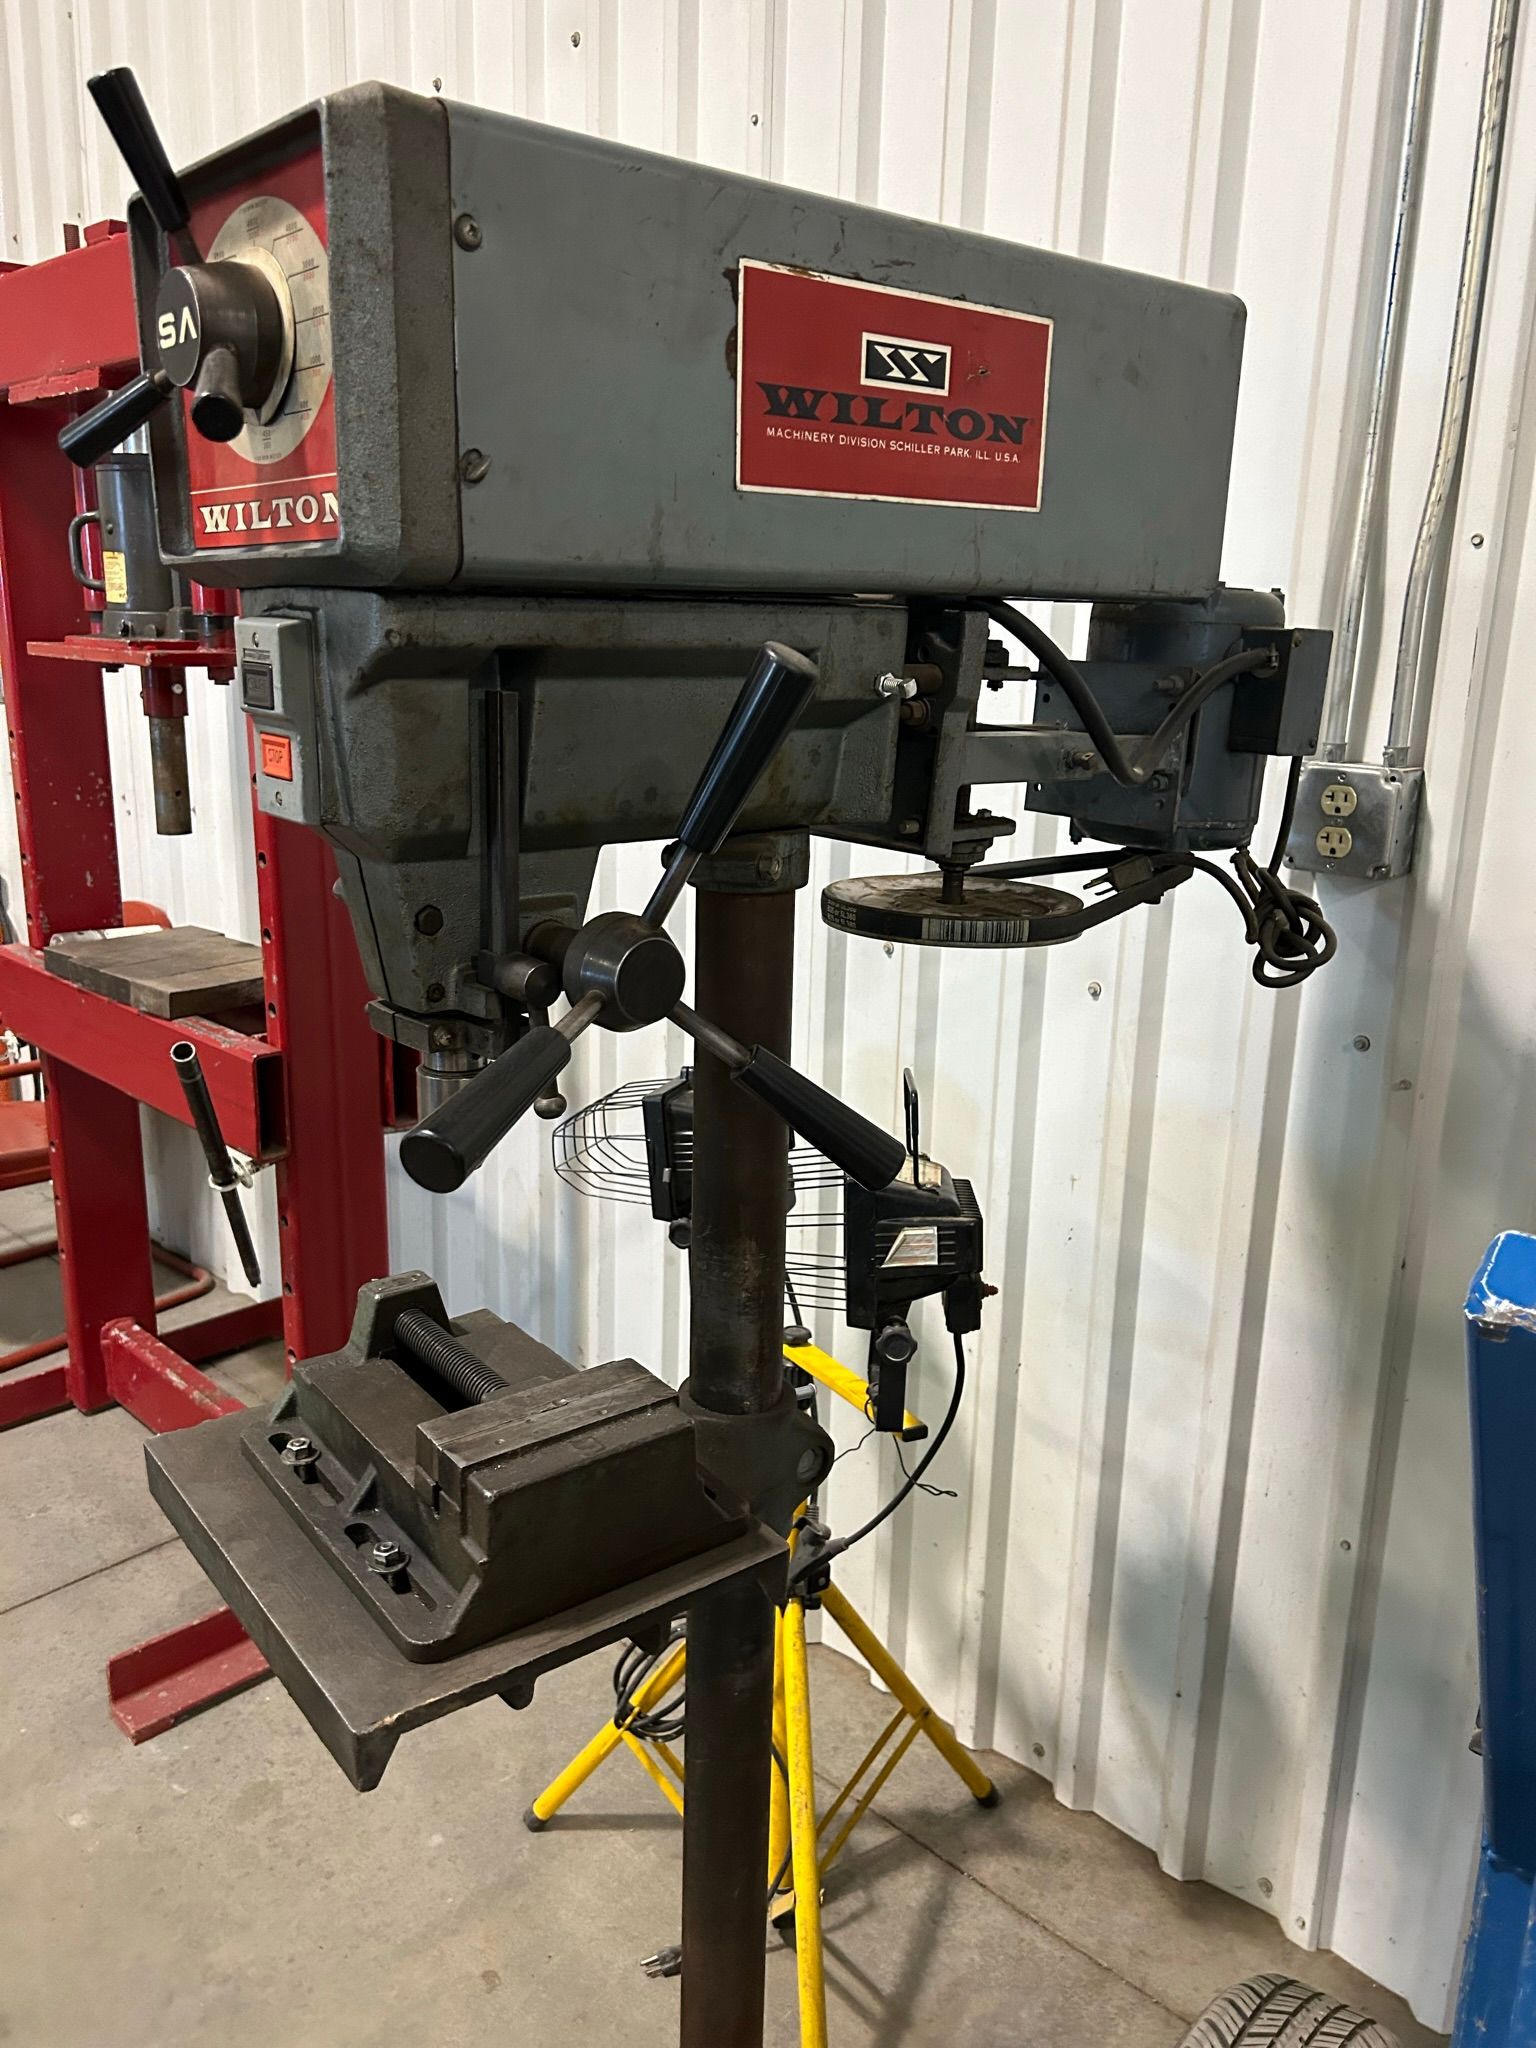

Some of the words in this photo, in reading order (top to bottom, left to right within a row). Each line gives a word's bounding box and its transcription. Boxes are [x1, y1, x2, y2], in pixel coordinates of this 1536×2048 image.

[756, 382, 1029, 445] WILTON
[766, 426, 834, 443] MACHINERY
[839, 434, 886, 449] DIVISION
[889, 440, 941, 455] SCHILLER
[267, 748, 284, 764] STOP
